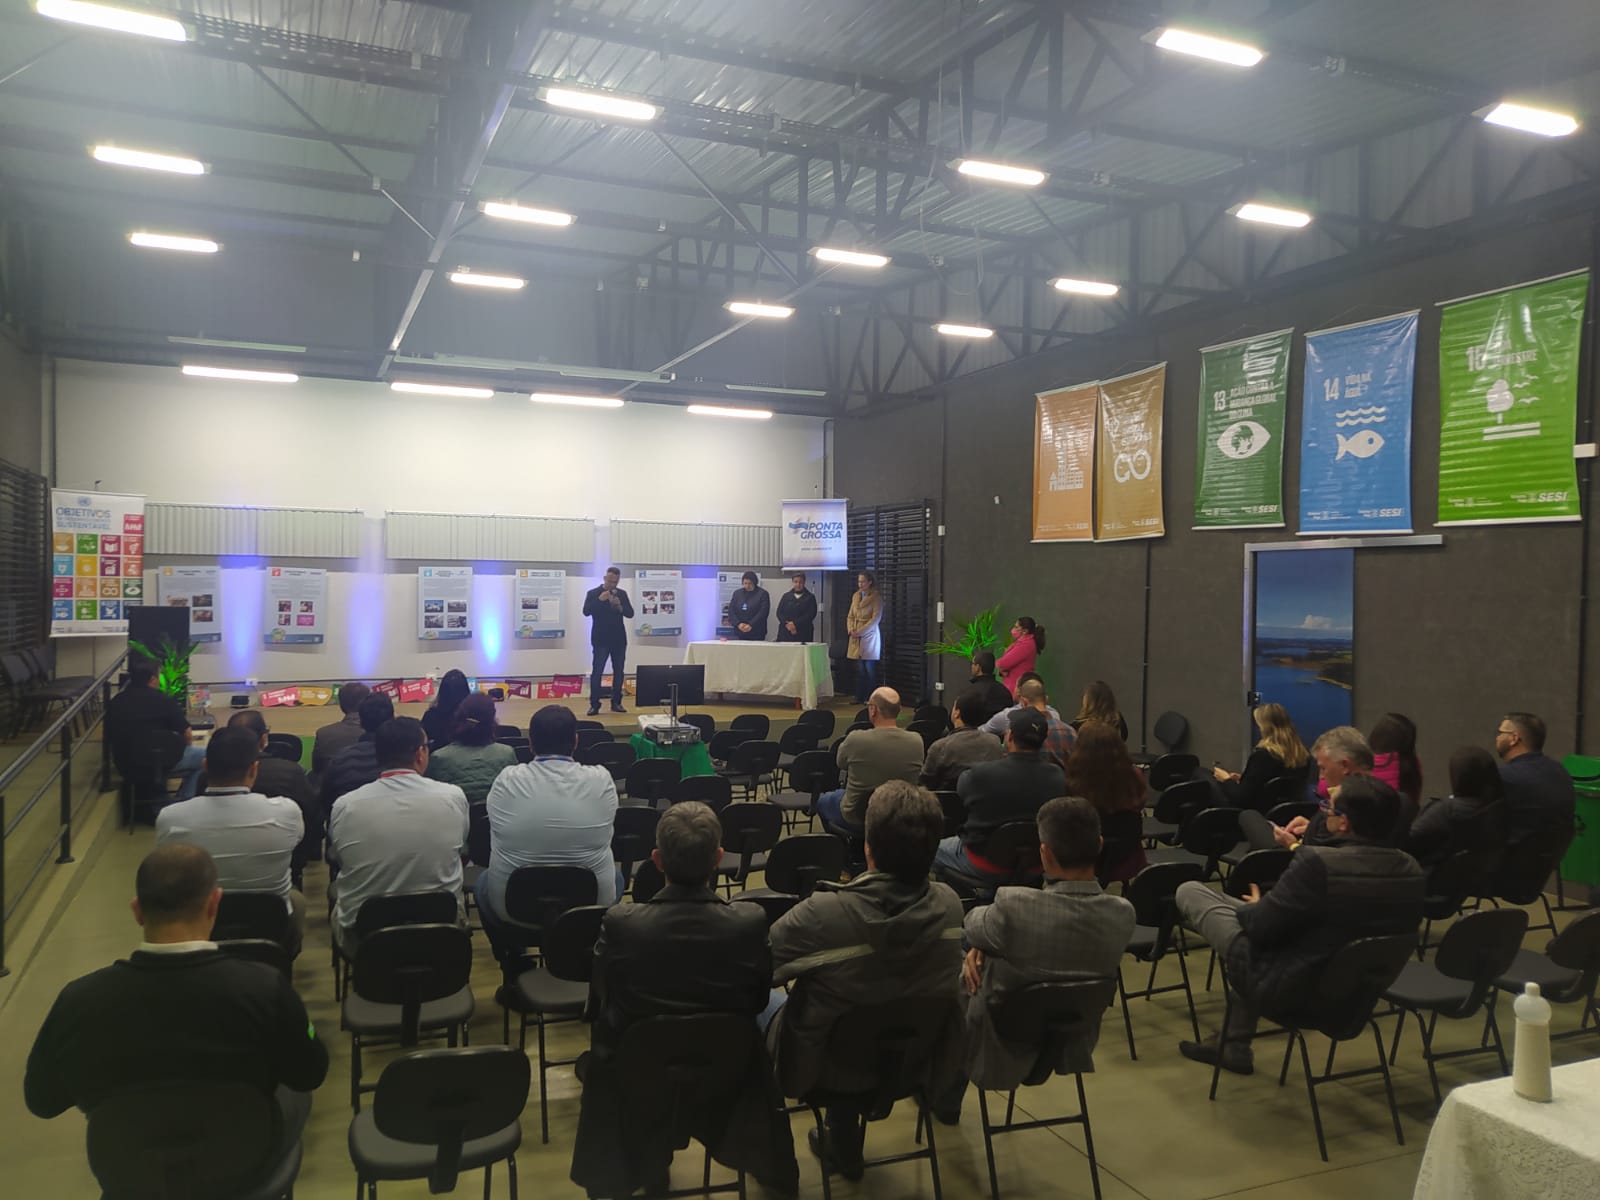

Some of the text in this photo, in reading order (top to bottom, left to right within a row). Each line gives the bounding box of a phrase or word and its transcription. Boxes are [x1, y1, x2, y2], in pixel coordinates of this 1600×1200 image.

[1324, 377, 1339, 401] 14
[1214, 390, 1226, 411] 13
[1538, 492, 1568, 503] SESI
[1257, 504, 1278, 514] SESI
[809, 522, 843, 530] PONTA
[800, 531, 841, 539] GROSSA
